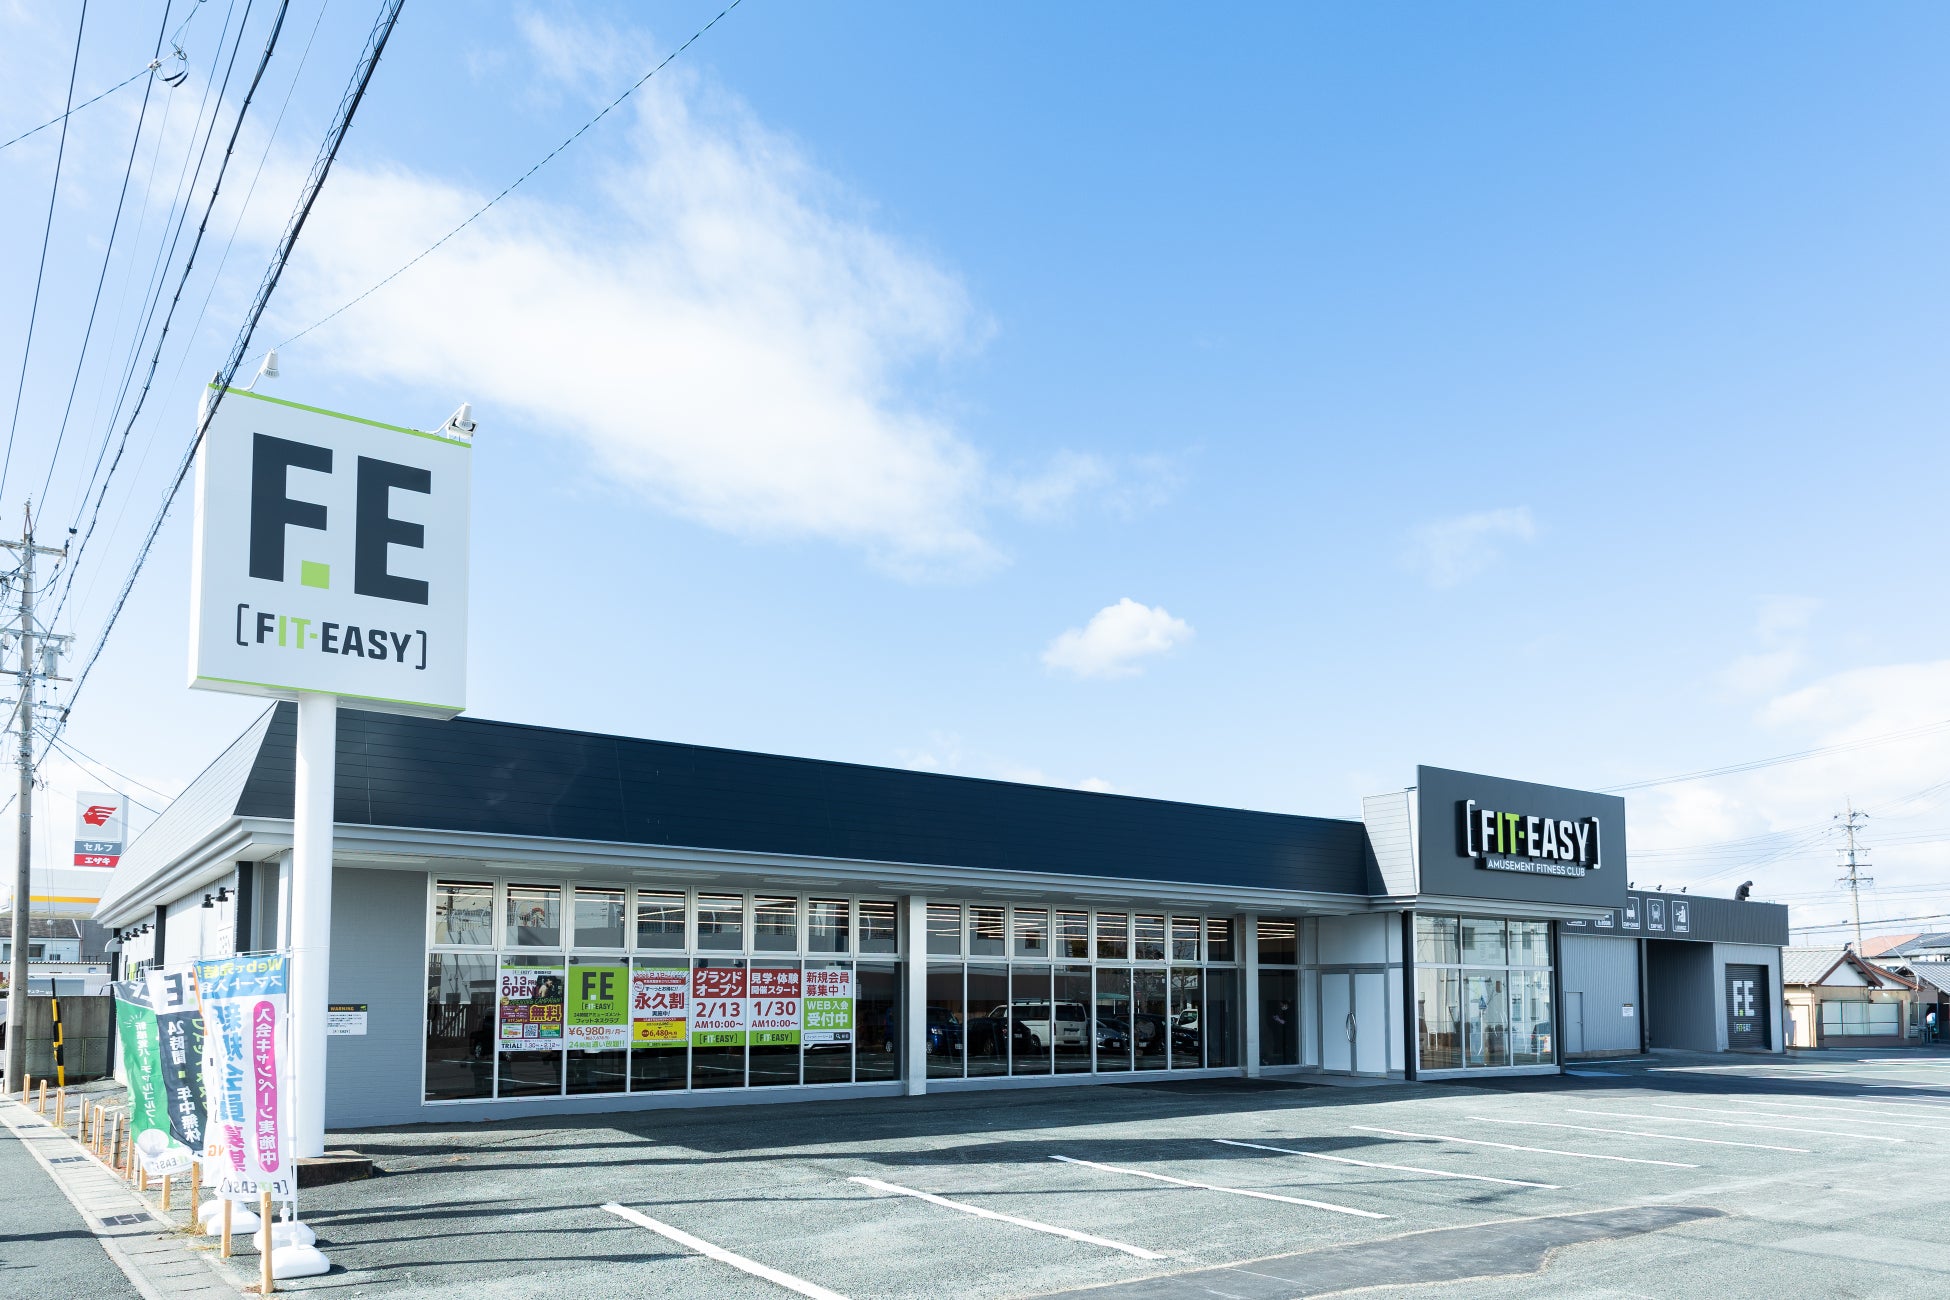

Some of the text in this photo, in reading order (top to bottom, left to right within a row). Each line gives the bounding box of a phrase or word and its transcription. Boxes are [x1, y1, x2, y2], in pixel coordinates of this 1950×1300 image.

[83, 842, 113, 852] セルフ
[84, 856, 111, 866] エザキ
[1487, 859, 1586, 877] AMUSEMENT FITNESS CLUB
[502, 975, 527, 986] 2.13
[696, 971, 743, 984] グランド
[751, 972, 799, 985] 見学・体験
[806, 971, 850, 984] 新規会員
[696, 984, 743, 997] オープン
[751, 985, 799, 995] 開催スタート
[634, 992, 685, 1010] 永久割
[806, 1000, 849, 1011] WEB入会
[529, 1004, 562, 1022] 無料
[696, 1001, 741, 1018] 2/13
[753, 1001, 797, 1018] 1/30
[807, 1012, 849, 1027] 受付中
